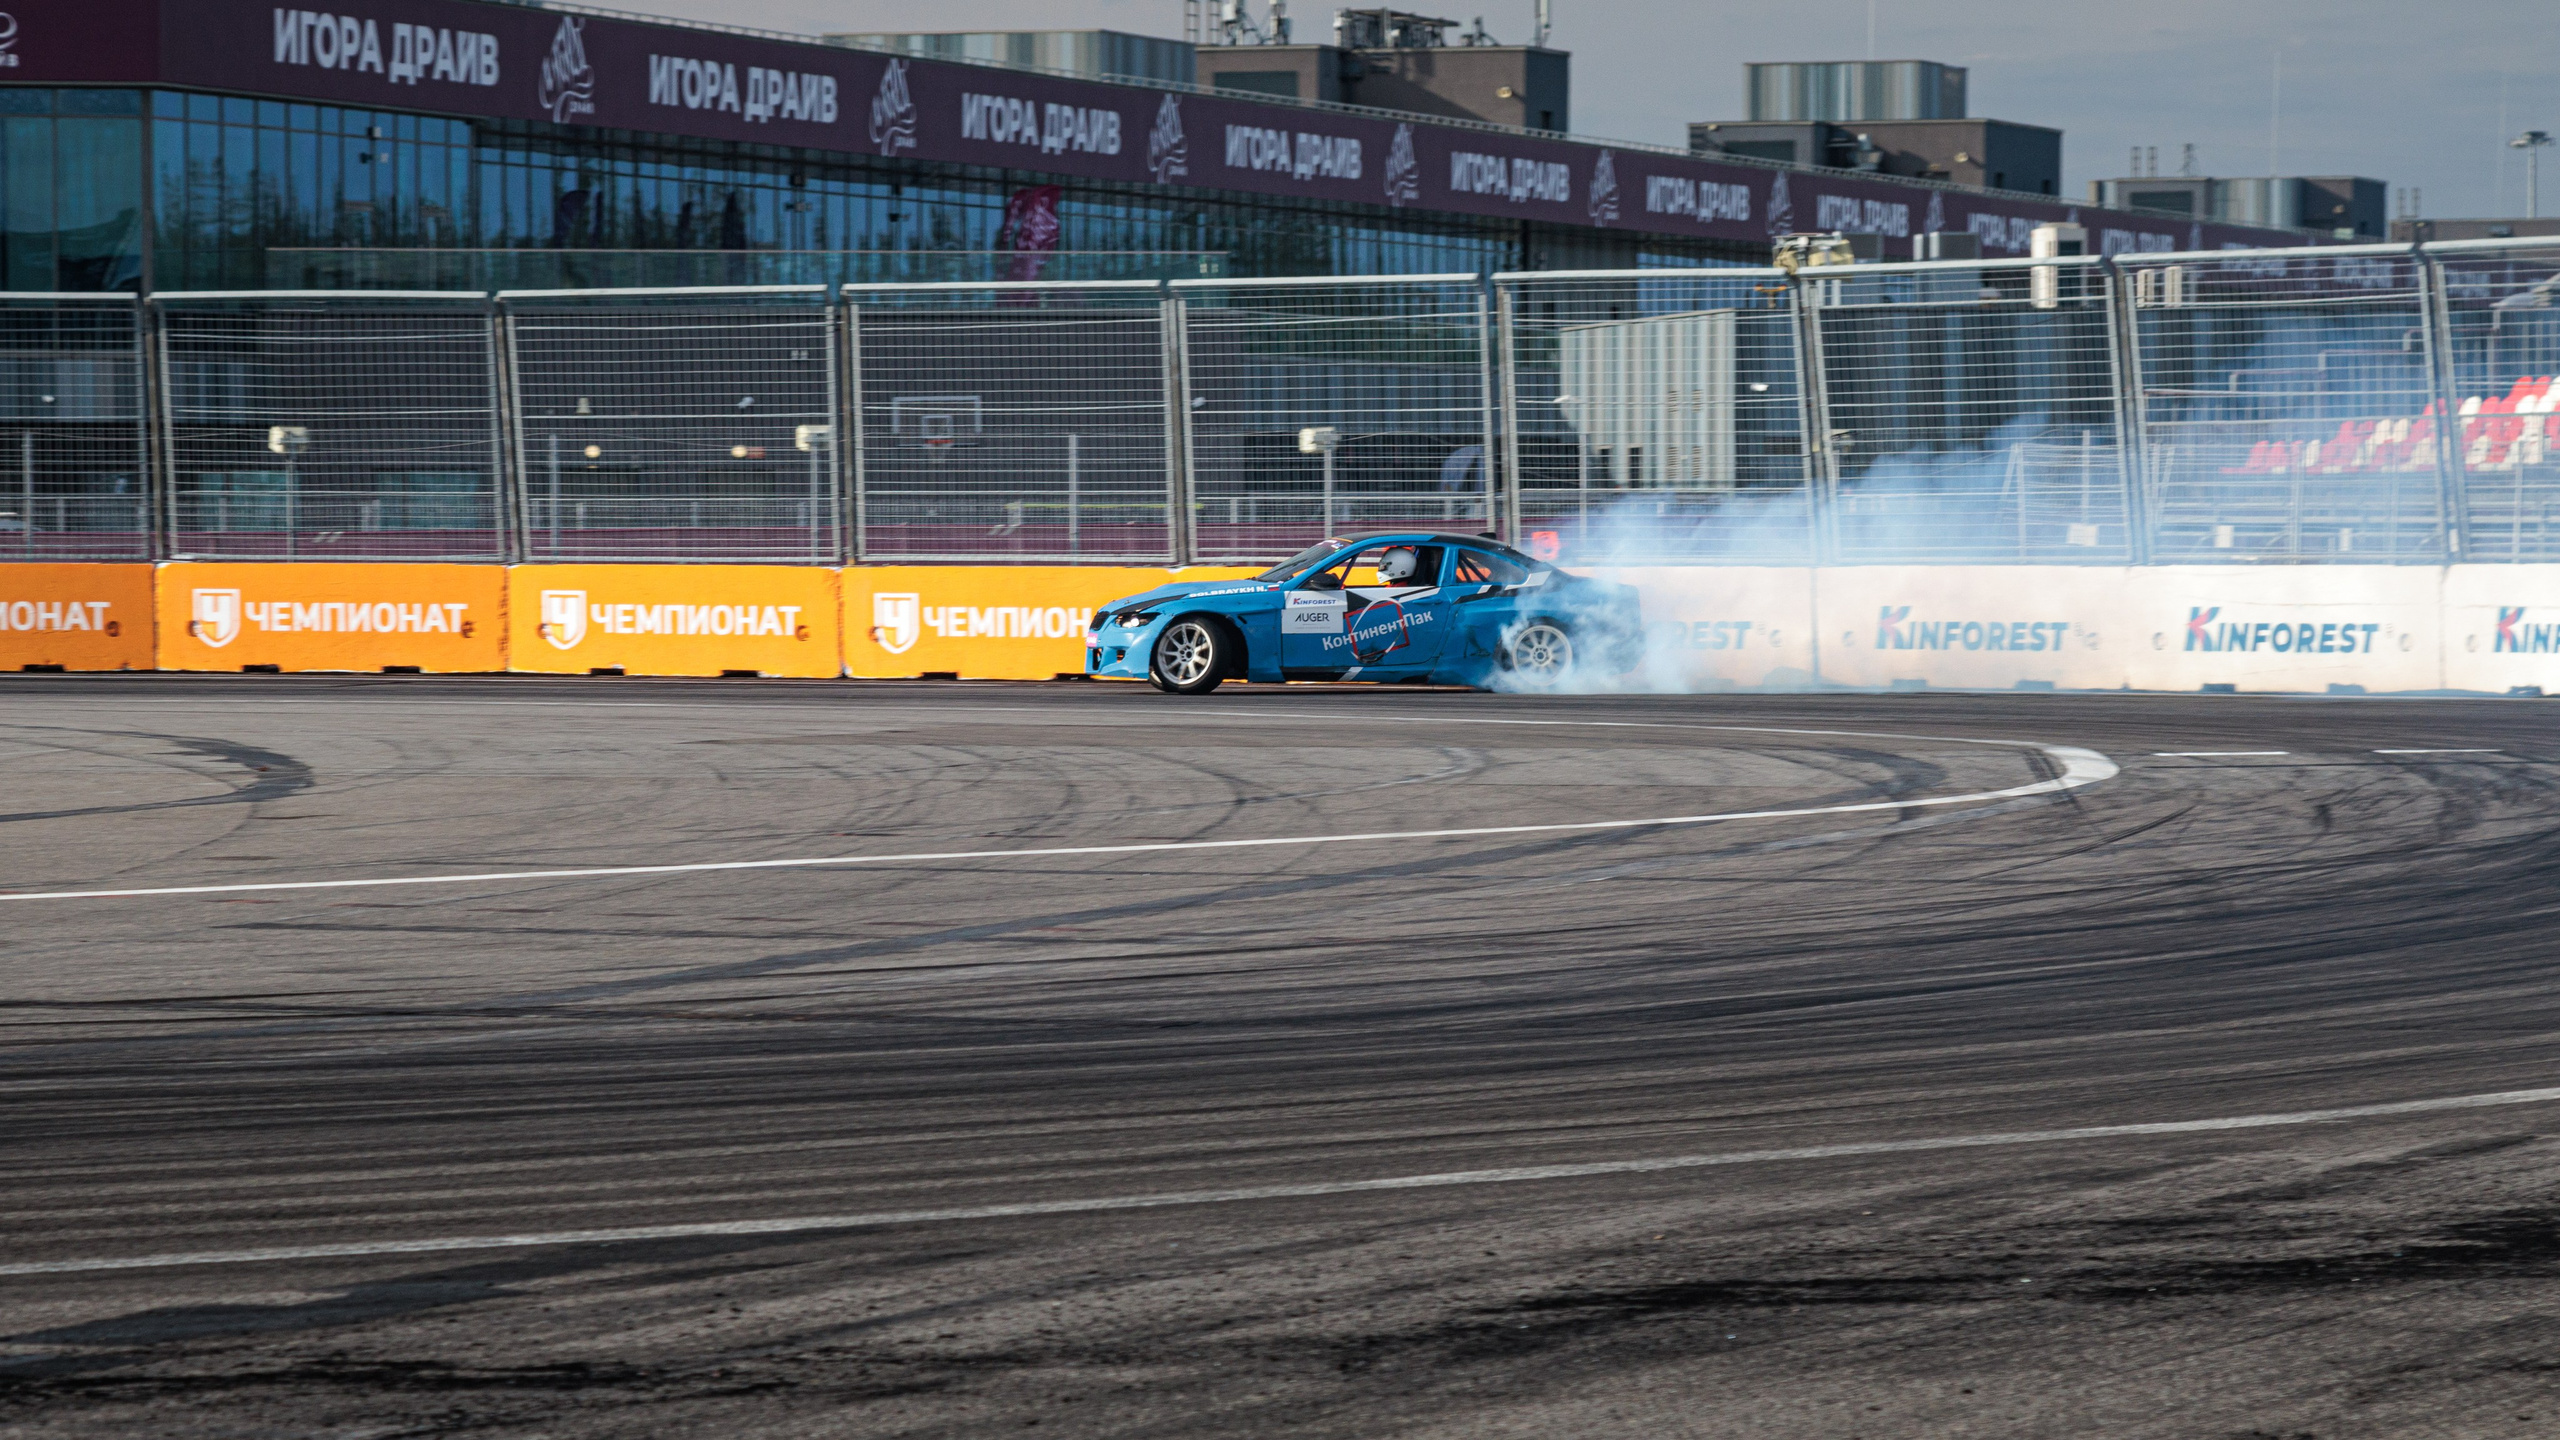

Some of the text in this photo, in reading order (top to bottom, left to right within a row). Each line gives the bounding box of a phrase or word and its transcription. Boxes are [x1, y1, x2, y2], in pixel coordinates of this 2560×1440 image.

[273, 7, 384, 74] ИГОРА
[649, 53, 742, 114] ИГОРА
[961, 92, 1040, 146] ИГОРА
[1225, 124, 1292, 172] ИГОРА
[245, 602, 468, 633] ЧЕМПИОНАТ
[590, 603, 802, 635] ЧЕМПИОНАТ
[922, 606, 1092, 638] ЧЕМПИОН
[1293, 597, 1337, 605] KINFOREST
[1294, 612, 1330, 623] AUGER
[1876, 605, 2068, 651] KINFOREST
[2184, 606, 2379, 653] KINFOREST
